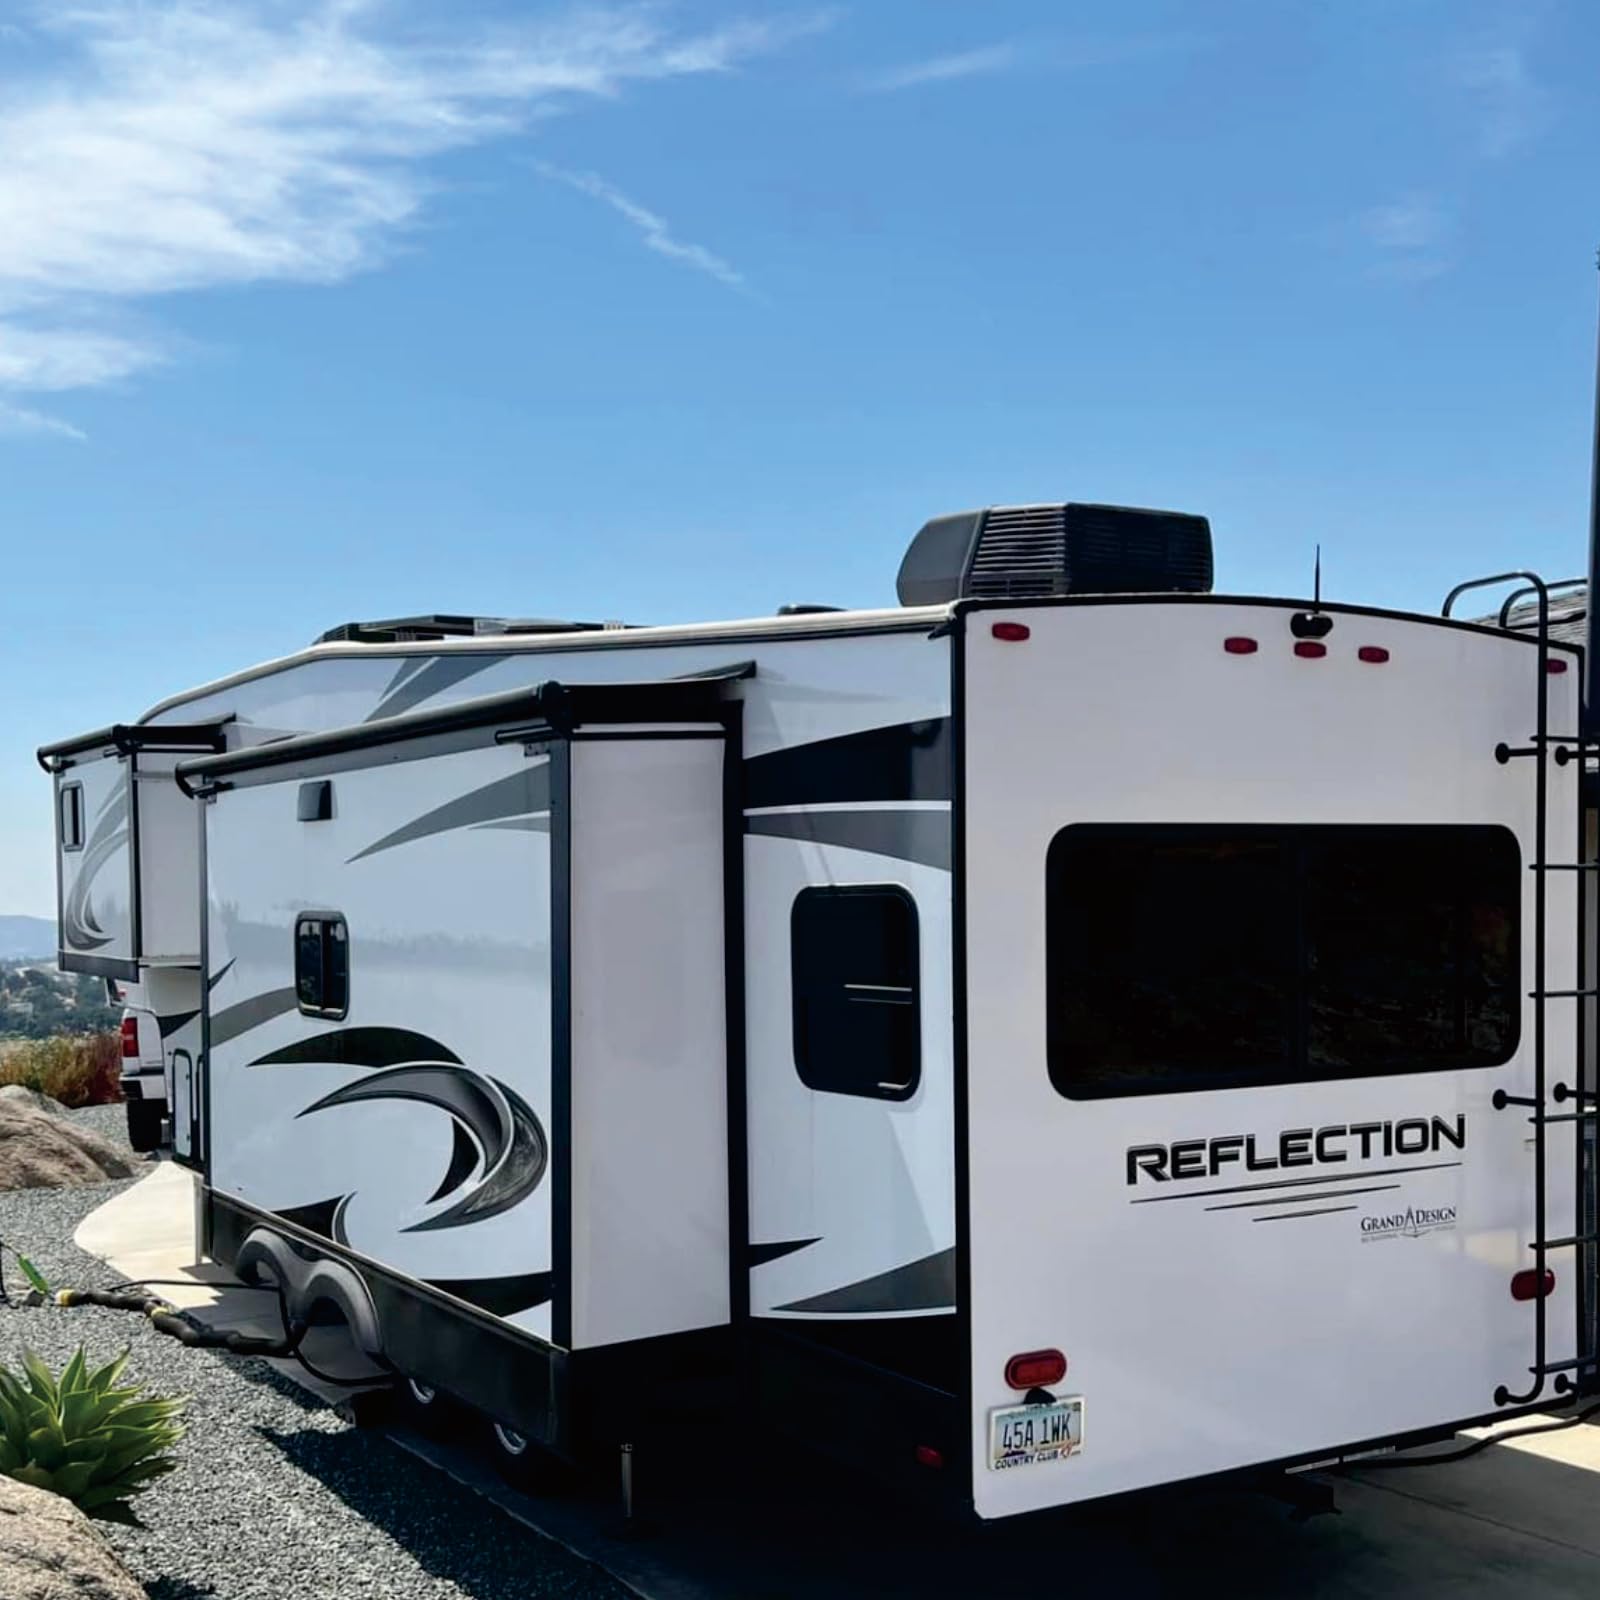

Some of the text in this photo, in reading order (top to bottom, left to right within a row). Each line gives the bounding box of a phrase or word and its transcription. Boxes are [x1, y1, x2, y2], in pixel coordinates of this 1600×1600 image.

[1127, 1114, 1465, 1185] REFLECTION
[1003, 1412, 1071, 1450] 45A 1WK
[995, 1455, 1034, 1470] COUNTRY
[1037, 1449, 1058, 1461] CLUB
